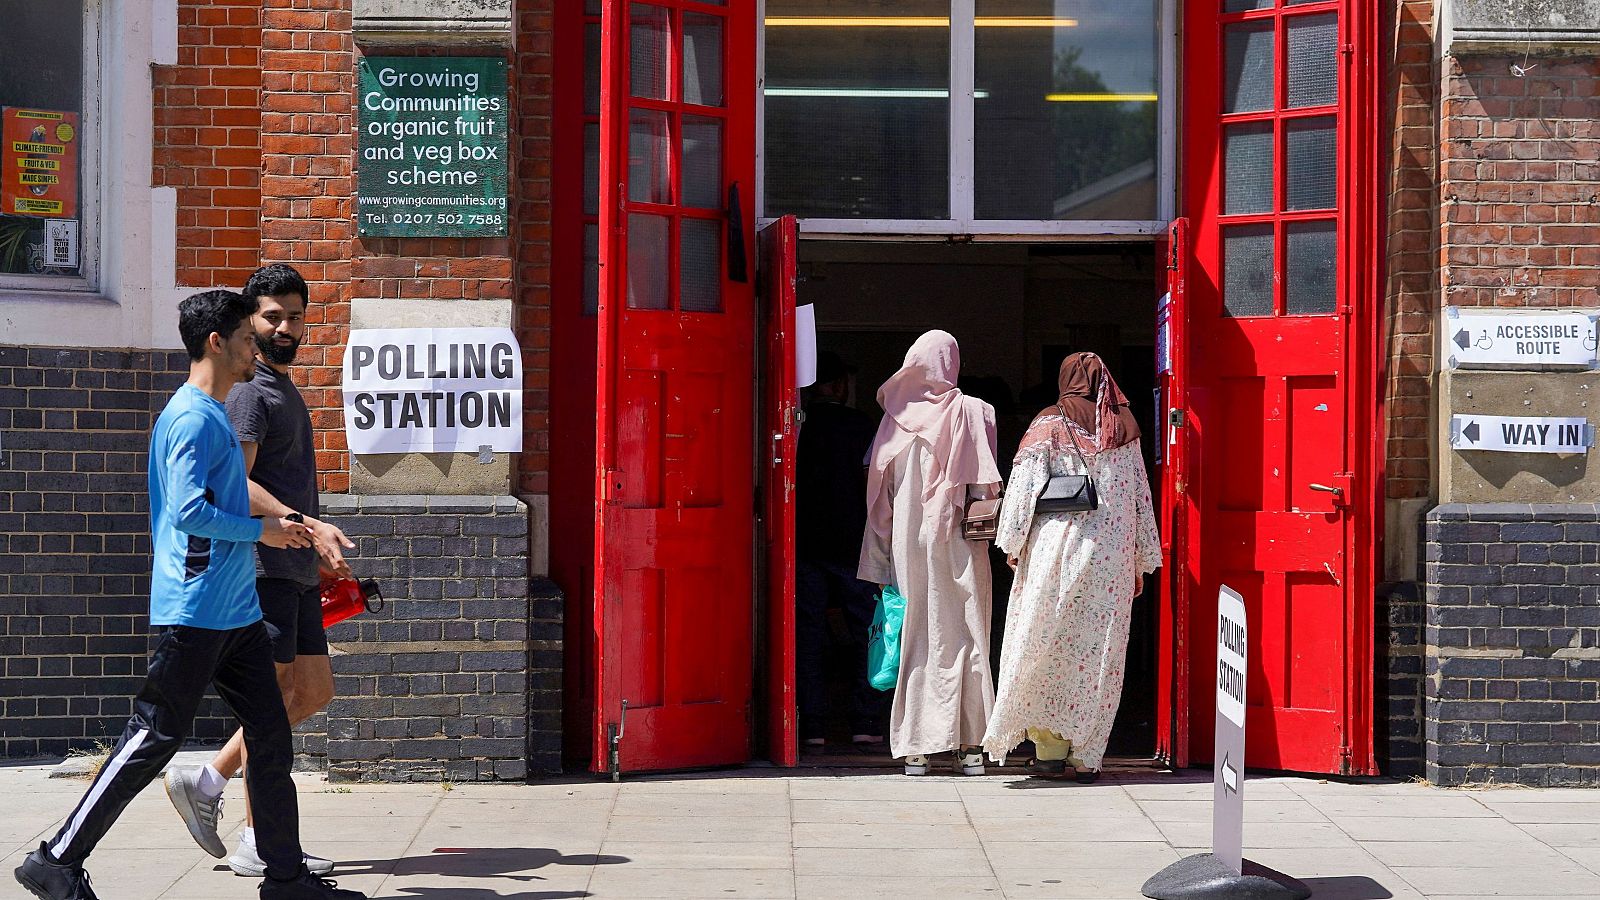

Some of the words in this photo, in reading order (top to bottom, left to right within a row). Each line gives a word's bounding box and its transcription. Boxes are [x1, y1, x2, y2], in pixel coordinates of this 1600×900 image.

[378, 67, 479, 92] Growing
[364, 92, 500, 111] Communities
[368, 117, 449, 140] organic
[454, 117, 495, 135] fruit
[15, 143, 63, 154] CLIMATE-FRIENDLY
[364, 142, 404, 160] and
[413, 145, 452, 164] veg
[458, 141, 498, 160] box
[24, 159, 40, 168] FRUIT
[40, 160, 45, 168] &
[45, 160, 56, 169] VEG
[22, 174, 37, 182] MADE
[37, 175, 57, 183] SIMPLE
[387, 166, 478, 185] scheme
[358, 194, 506, 209] www.growingcommunities.org
[366, 213, 388, 224] Tel.
[393, 213, 432, 224] 0207
[437, 213, 464, 224] 502
[468, 214, 502, 225] 7588
[1496, 325, 1579, 338] ACCESSIBLE
[1516, 341, 1560, 355] ROUTE
[351, 342, 514, 381] POLLING
[353, 391, 511, 430] STATION
[1502, 423, 1550, 446] WAY
[1558, 424, 1579, 446] IN
[1219, 613, 1245, 659] POLLING
[1218, 658, 1244, 705] STATION
